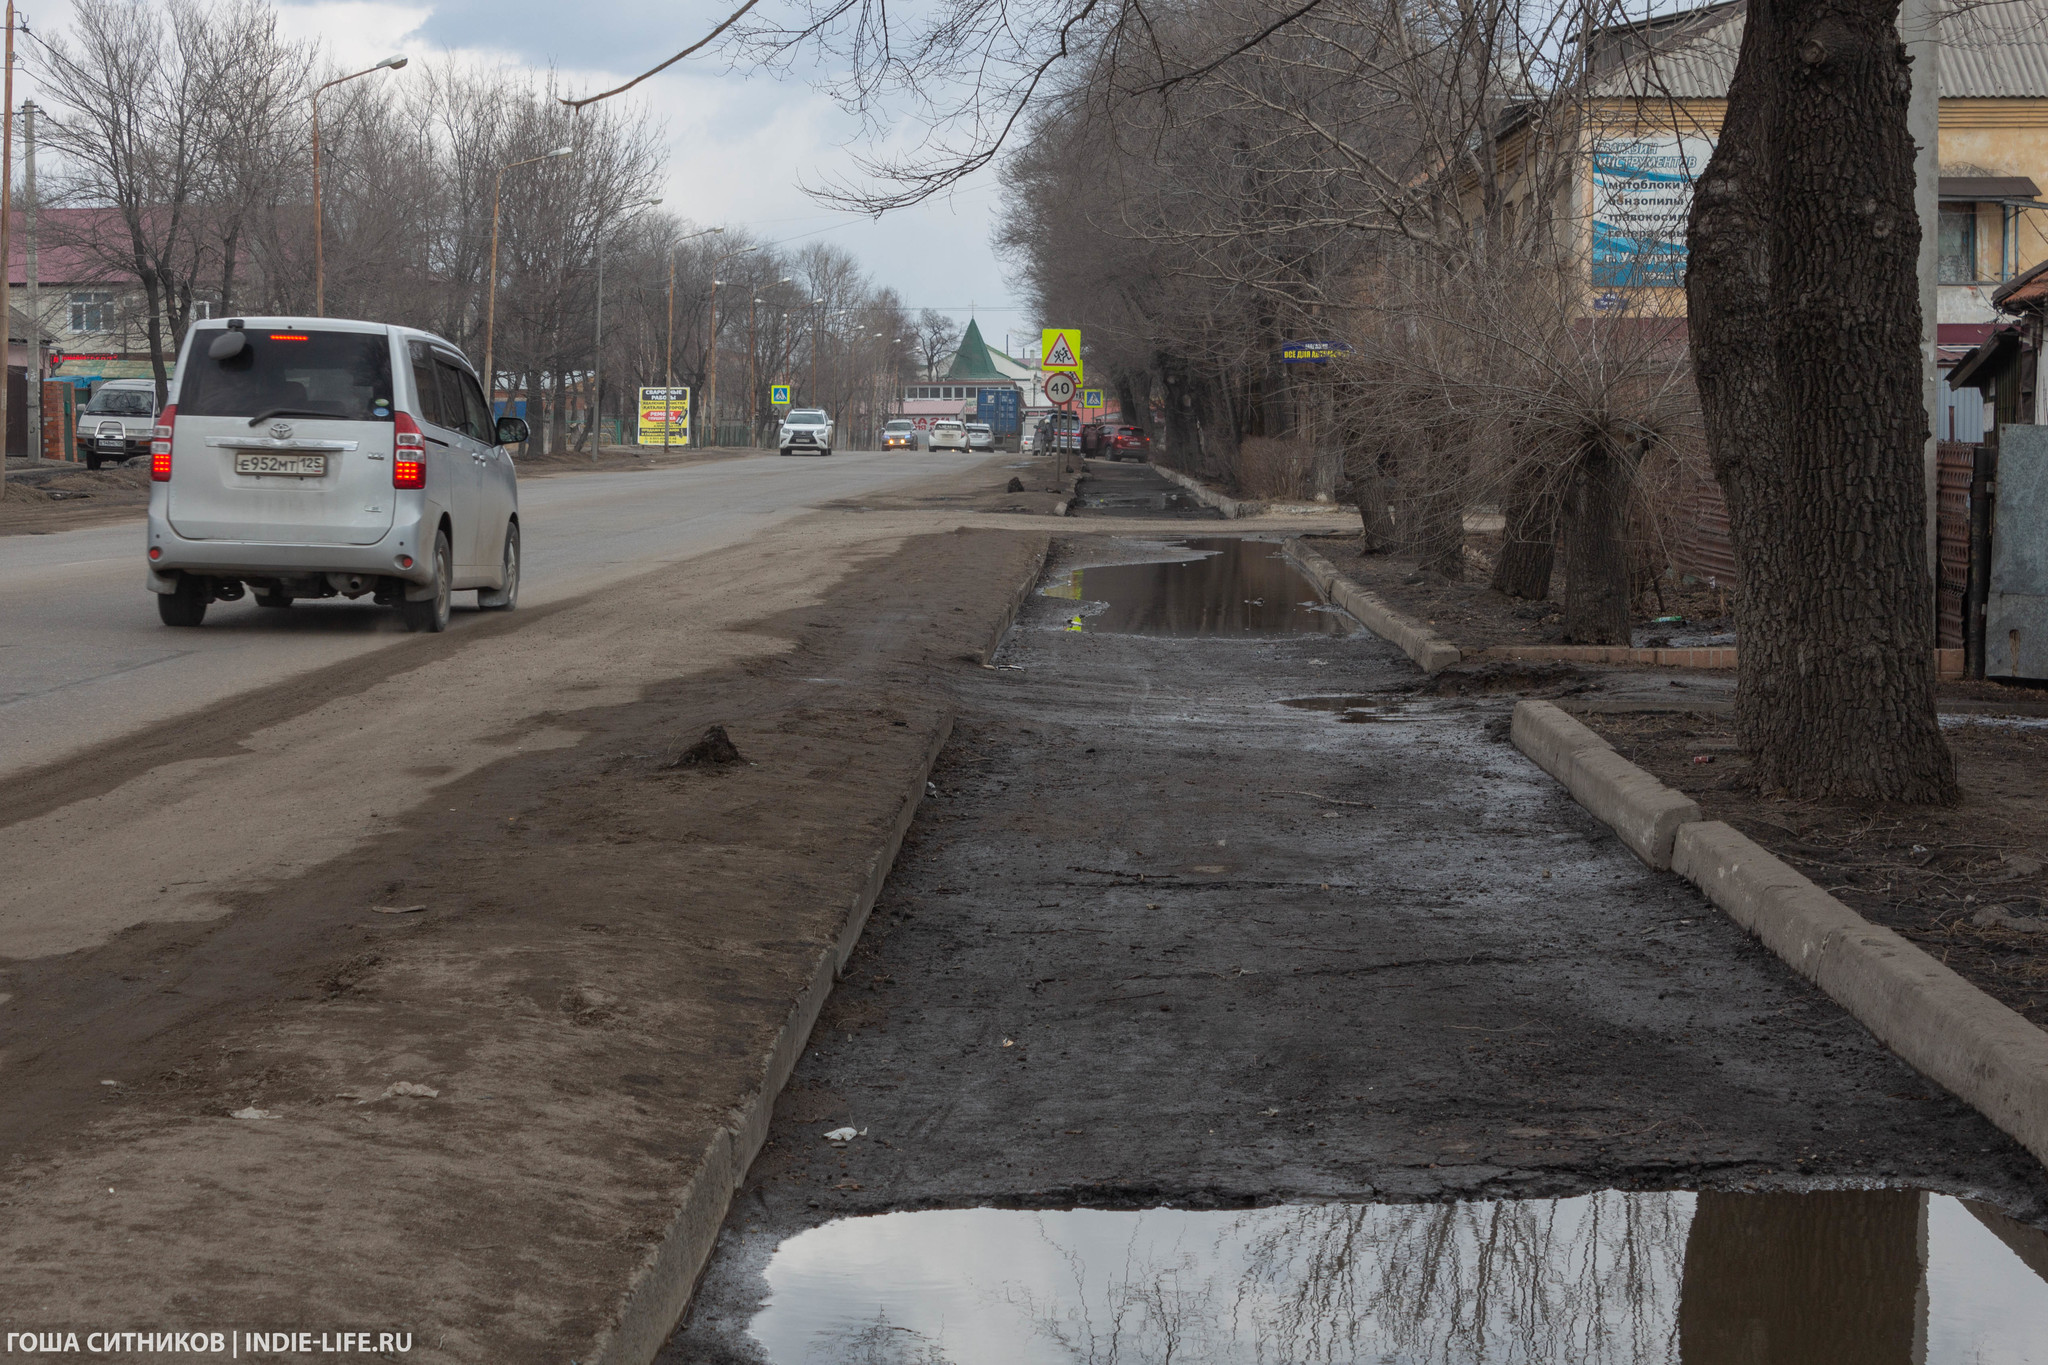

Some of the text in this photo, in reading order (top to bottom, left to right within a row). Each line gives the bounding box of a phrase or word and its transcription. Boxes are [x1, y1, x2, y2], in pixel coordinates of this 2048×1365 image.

[1598, 156, 1697, 169] ИНСТРУМЕНТОВ
[1608, 180, 1680, 190] мотоблоки
[1608, 214, 1688, 223] травокосил
[1051, 382, 1070, 395] 40
